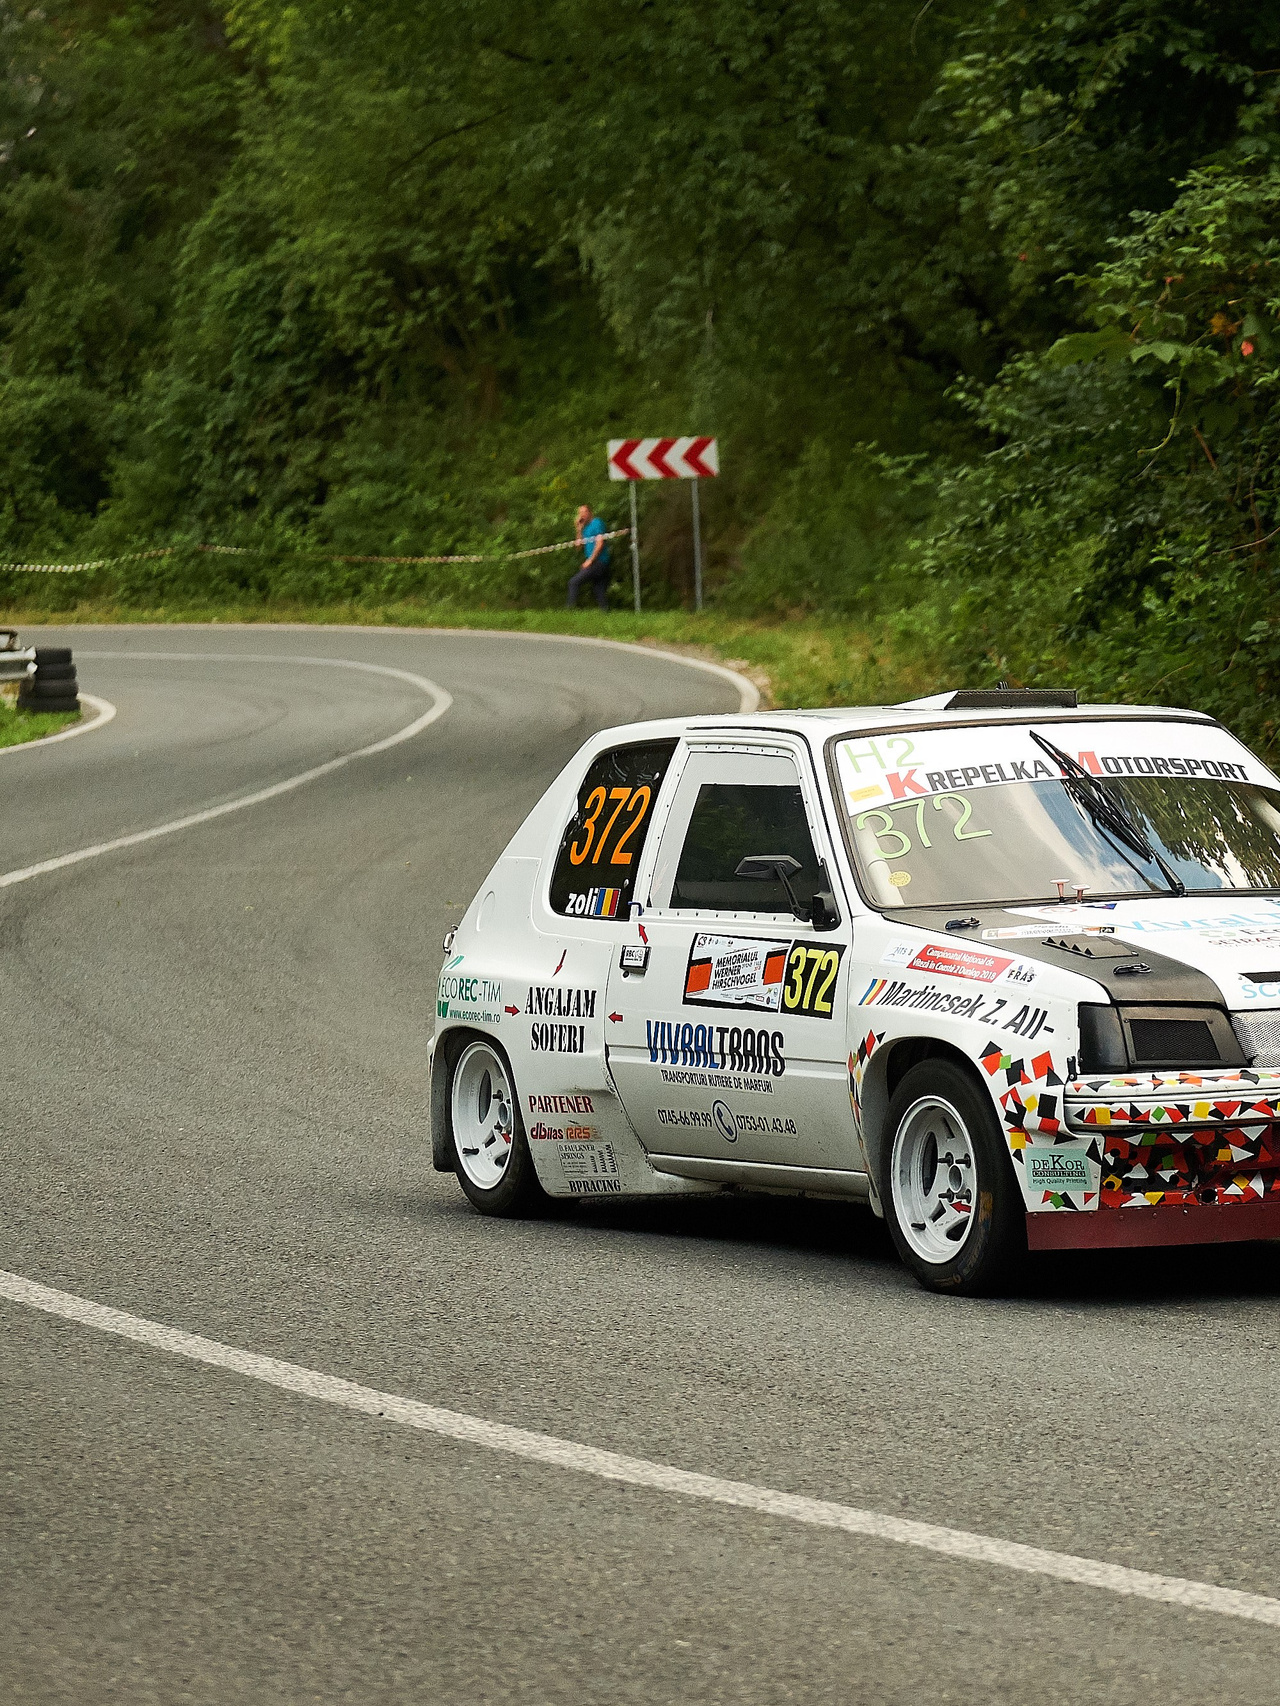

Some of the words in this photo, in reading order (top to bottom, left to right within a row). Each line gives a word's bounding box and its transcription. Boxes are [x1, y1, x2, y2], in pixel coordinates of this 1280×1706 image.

[844, 737, 925, 774] H2
[886, 759, 1054, 799] KREPELKA
[569, 785, 651, 866] 372
[856, 793, 993, 859] 372
[565, 887, 600, 915] zoli
[715, 951, 758, 968] MEMORIALUL
[926, 947, 962, 961] Campionatul
[985, 957, 995, 967] de
[711, 972, 757, 990] HIRSCHVOGEL
[714, 964, 742, 980] WERNER
[784, 946, 840, 1013] 372
[979, 969, 997, 981] 2018
[524, 986, 597, 1019] ANGAJAM
[876, 980, 986, 1019] Martincsek
[450, 1009, 501, 1024] www.ecorec-tim.ro
[530, 1022, 586, 1054] SOFERI
[660, 1069, 708, 1086] TRANSPORTURI
[708, 1075, 734, 1089] RUTIERE
[733, 1078, 743, 1090] DE
[743, 1079, 774, 1094] MARFURI
[528, 1094, 595, 1114] PARTENER
[657, 1108, 713, 1128] 0745-66.99.99
[736, 1114, 797, 1135] 0753-01.43.48
[560, 1152, 585, 1160] SPRINGS
[568, 1179, 621, 1193] BPRACING
[1032, 1170, 1086, 1178] CONSULTING
